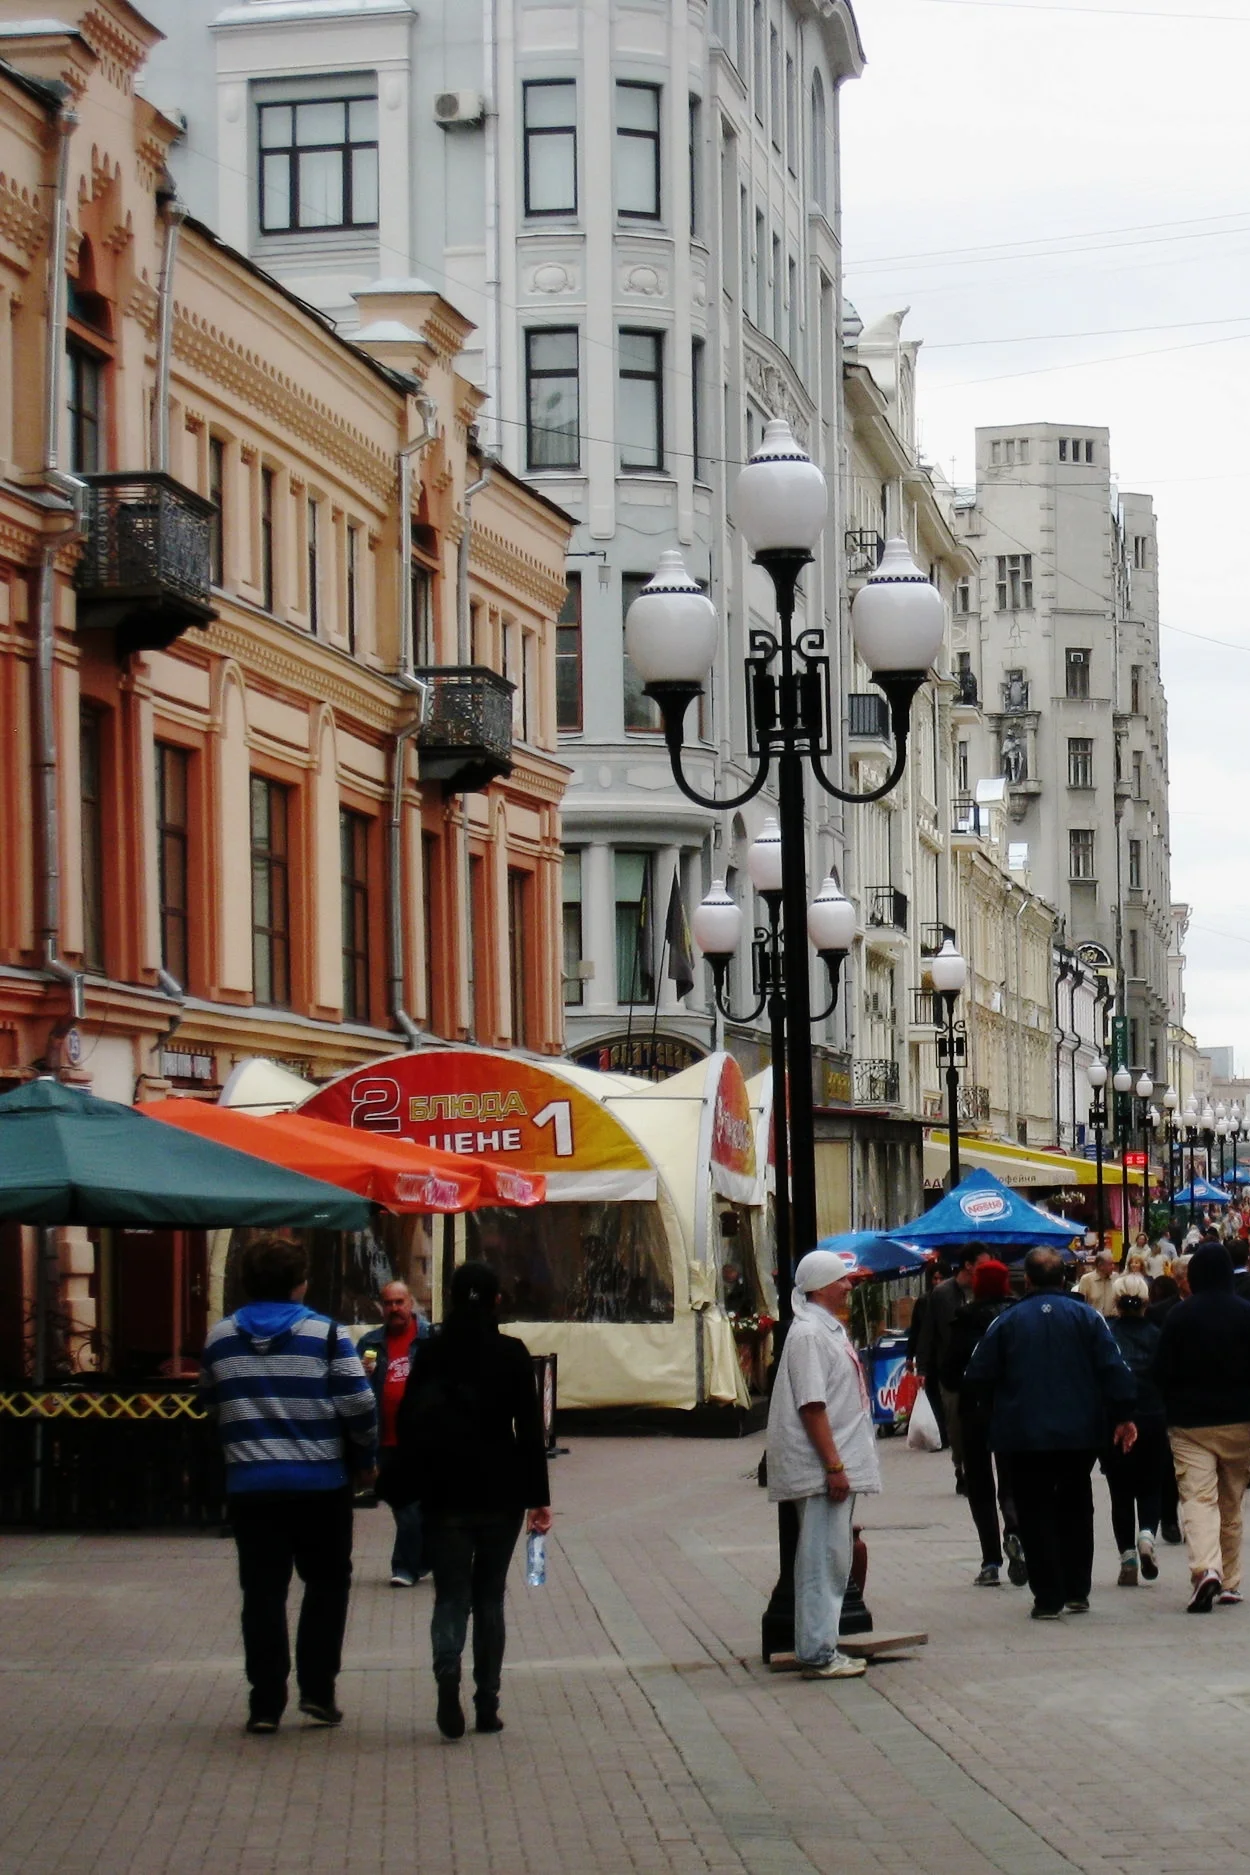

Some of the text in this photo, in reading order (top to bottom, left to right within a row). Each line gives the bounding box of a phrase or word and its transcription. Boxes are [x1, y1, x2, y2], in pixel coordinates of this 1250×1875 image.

[351, 1077, 528, 1133] 2 БЛЮДА
[429, 1100, 574, 1157] ЦЕНЕ 1
